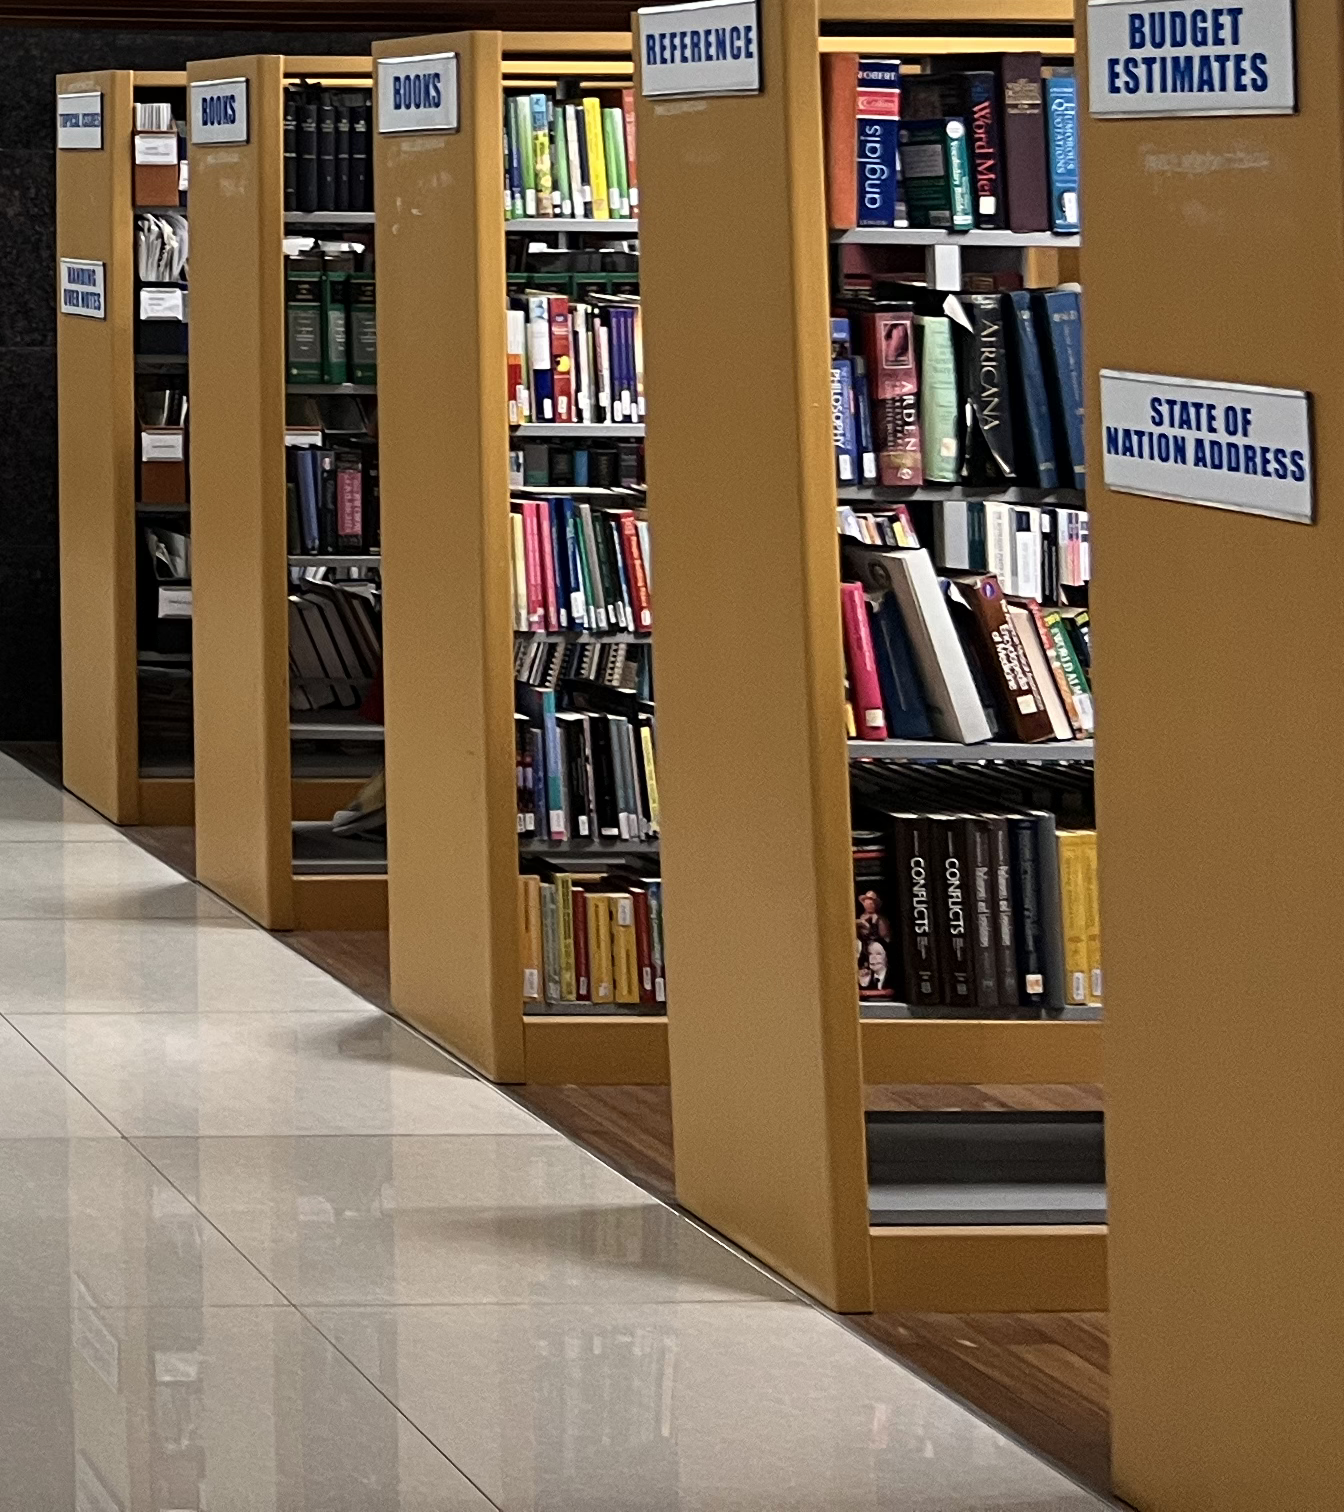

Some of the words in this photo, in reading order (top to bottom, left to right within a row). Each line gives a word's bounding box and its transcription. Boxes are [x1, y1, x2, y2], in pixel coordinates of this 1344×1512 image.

[645, 24, 754, 65] REFERENCE
[1128, 7, 1244, 49] BUDGET
[393, 73, 441, 110] BOOKS
[1107, 52, 1268, 95] ESTIMATES
[201, 94, 236, 126] BOOKS
[973, 101, 994, 152] Word
[857, 124, 890, 209] anglais
[980, 319, 1000, 430] AFRICANA
[830, 368, 845, 449] PHILOSOPHY
[901, 380, 917, 451] ARDEN
[1150, 397, 1218, 435] STATE
[1223, 404, 1251, 435] OF
[1105, 426, 1188, 467] NATION
[1193, 438, 1305, 484] ADDRESS
[911, 857, 929, 933] CONFLICTS
[946, 858, 964, 935] CONFLICTS
